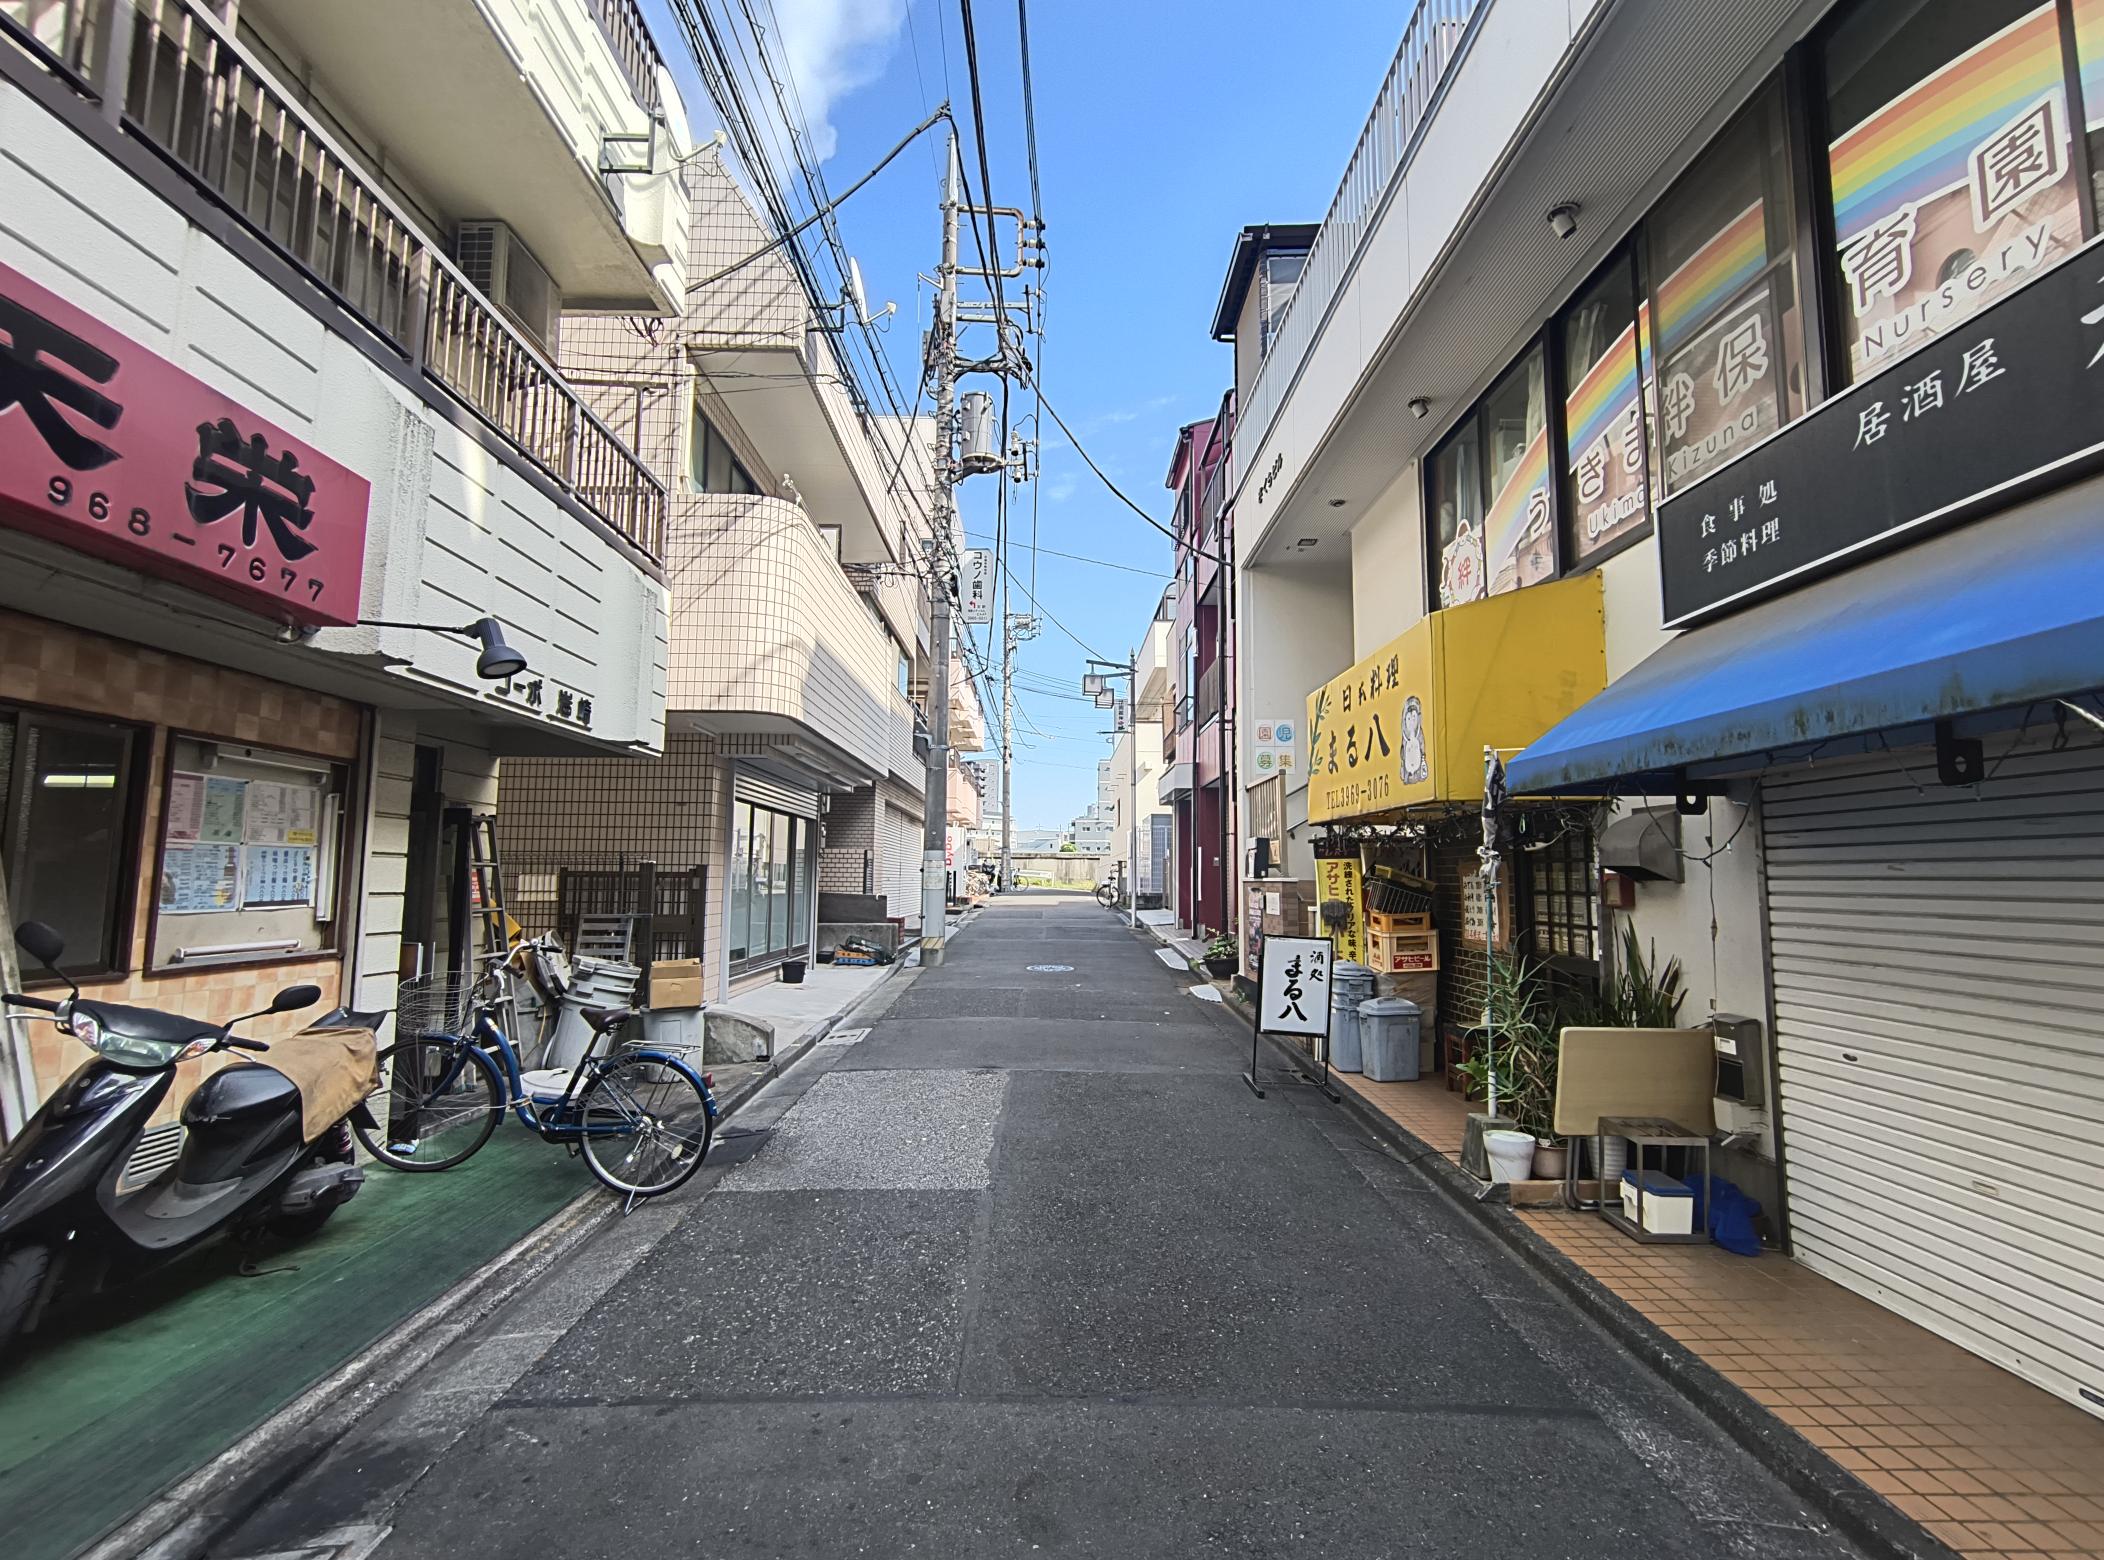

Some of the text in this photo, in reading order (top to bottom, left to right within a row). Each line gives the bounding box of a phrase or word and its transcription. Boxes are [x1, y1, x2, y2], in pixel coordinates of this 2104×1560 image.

[1667, 407, 1758, 479] Kizuna
[1863, 223, 2047, 358] Nursery
[1852, 337, 2007, 452] 居酒屋
[1701, 479, 1778, 538] 食事処
[1702, 517, 1781, 573] 季節料理
[972, 551, 983, 600] コウノ歯科
[1327, 712, 1391, 775] まる八
[945, 835, 954, 866] DyDo
[1277, 954, 1308, 1022] まる八
[1309, 950, 1324, 982] 酒処
[1394, 955, 1432, 964] アサヒビール
